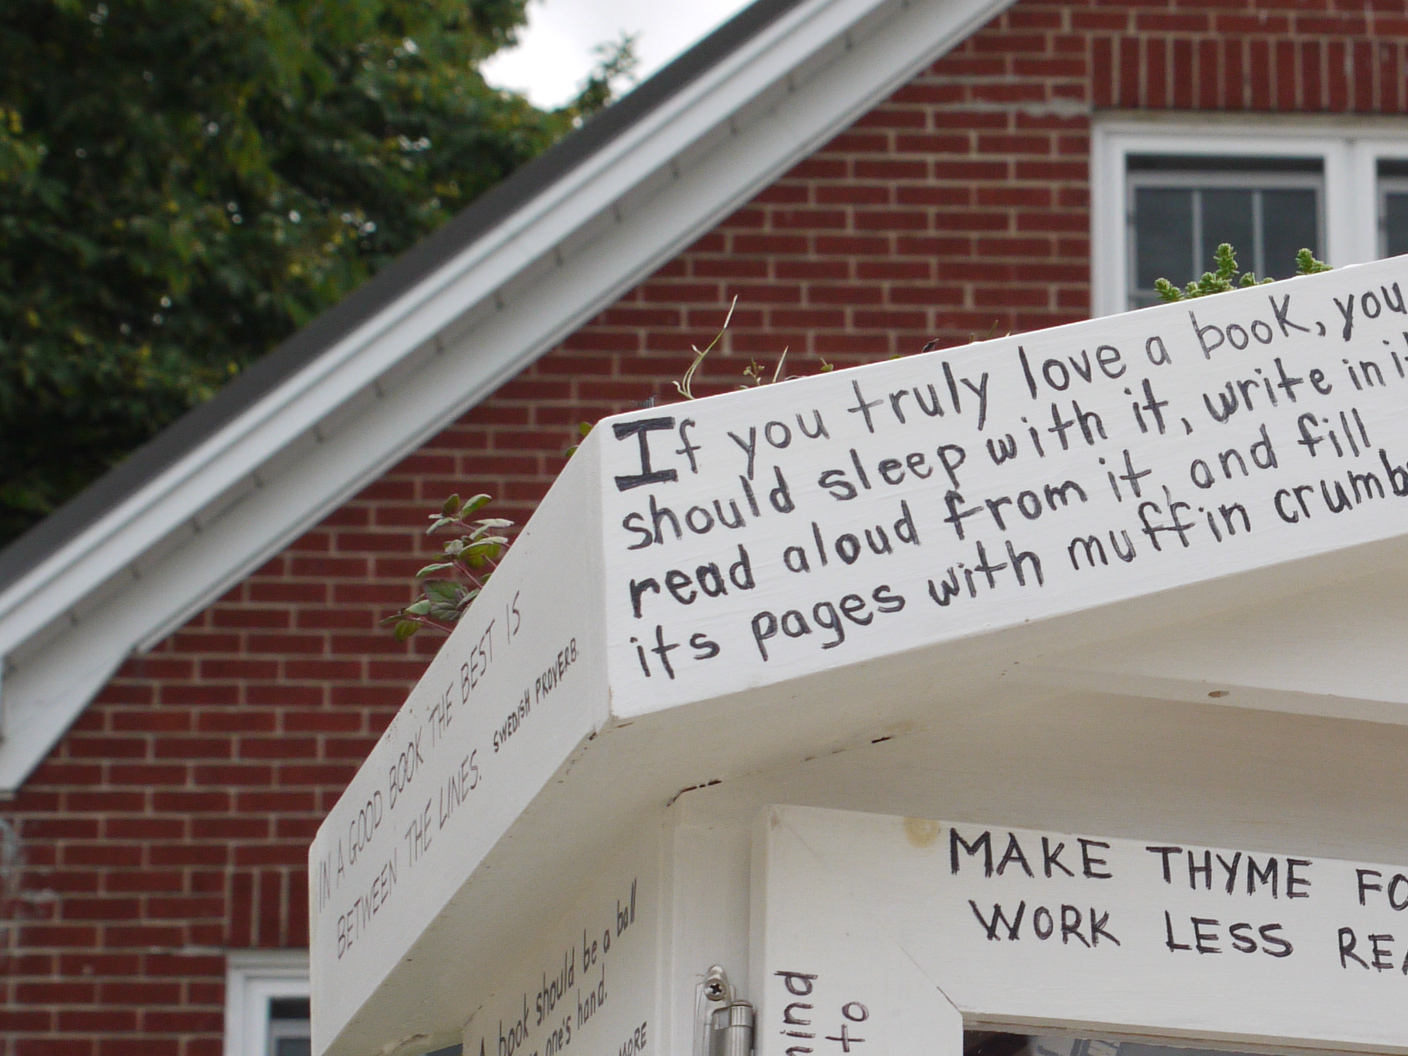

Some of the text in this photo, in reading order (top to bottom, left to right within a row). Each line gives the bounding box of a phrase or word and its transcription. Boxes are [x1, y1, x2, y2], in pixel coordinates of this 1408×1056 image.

[612, 282, 1408, 491] If you truly love a book, you
[622, 465, 796, 551] should
[818, 444, 966, 501] sleep
[986, 400, 1108, 466] with
[1124, 378, 1193, 435] it,
[1203, 357, 1332, 424] write
[1342, 358, 1386, 391] in
[629, 543, 756, 618] read
[783, 500, 921, 573] aloud
[944, 480, 1088, 541] from
[1190, 424, 1278, 489] and
[1298, 407, 1371, 458] fill
[629, 625, 721, 680] its
[751, 585, 905, 662] pages
[928, 539, 1044, 607] with
[1068, 500, 1251, 571] muffin
[319, 590, 522, 913] IN A GOOD BOOK THE BEST IS
[493, 689, 531, 753] SWEDISH
[337, 748, 482, 960] BETWEEN THE LINES.
[949, 827, 1112, 881] MAKE
[1146, 845, 1313, 899] THYME
[968, 899, 1121, 949] WORK
[1166, 911, 1294, 958] LESS
[824, 1001, 870, 1053] to
